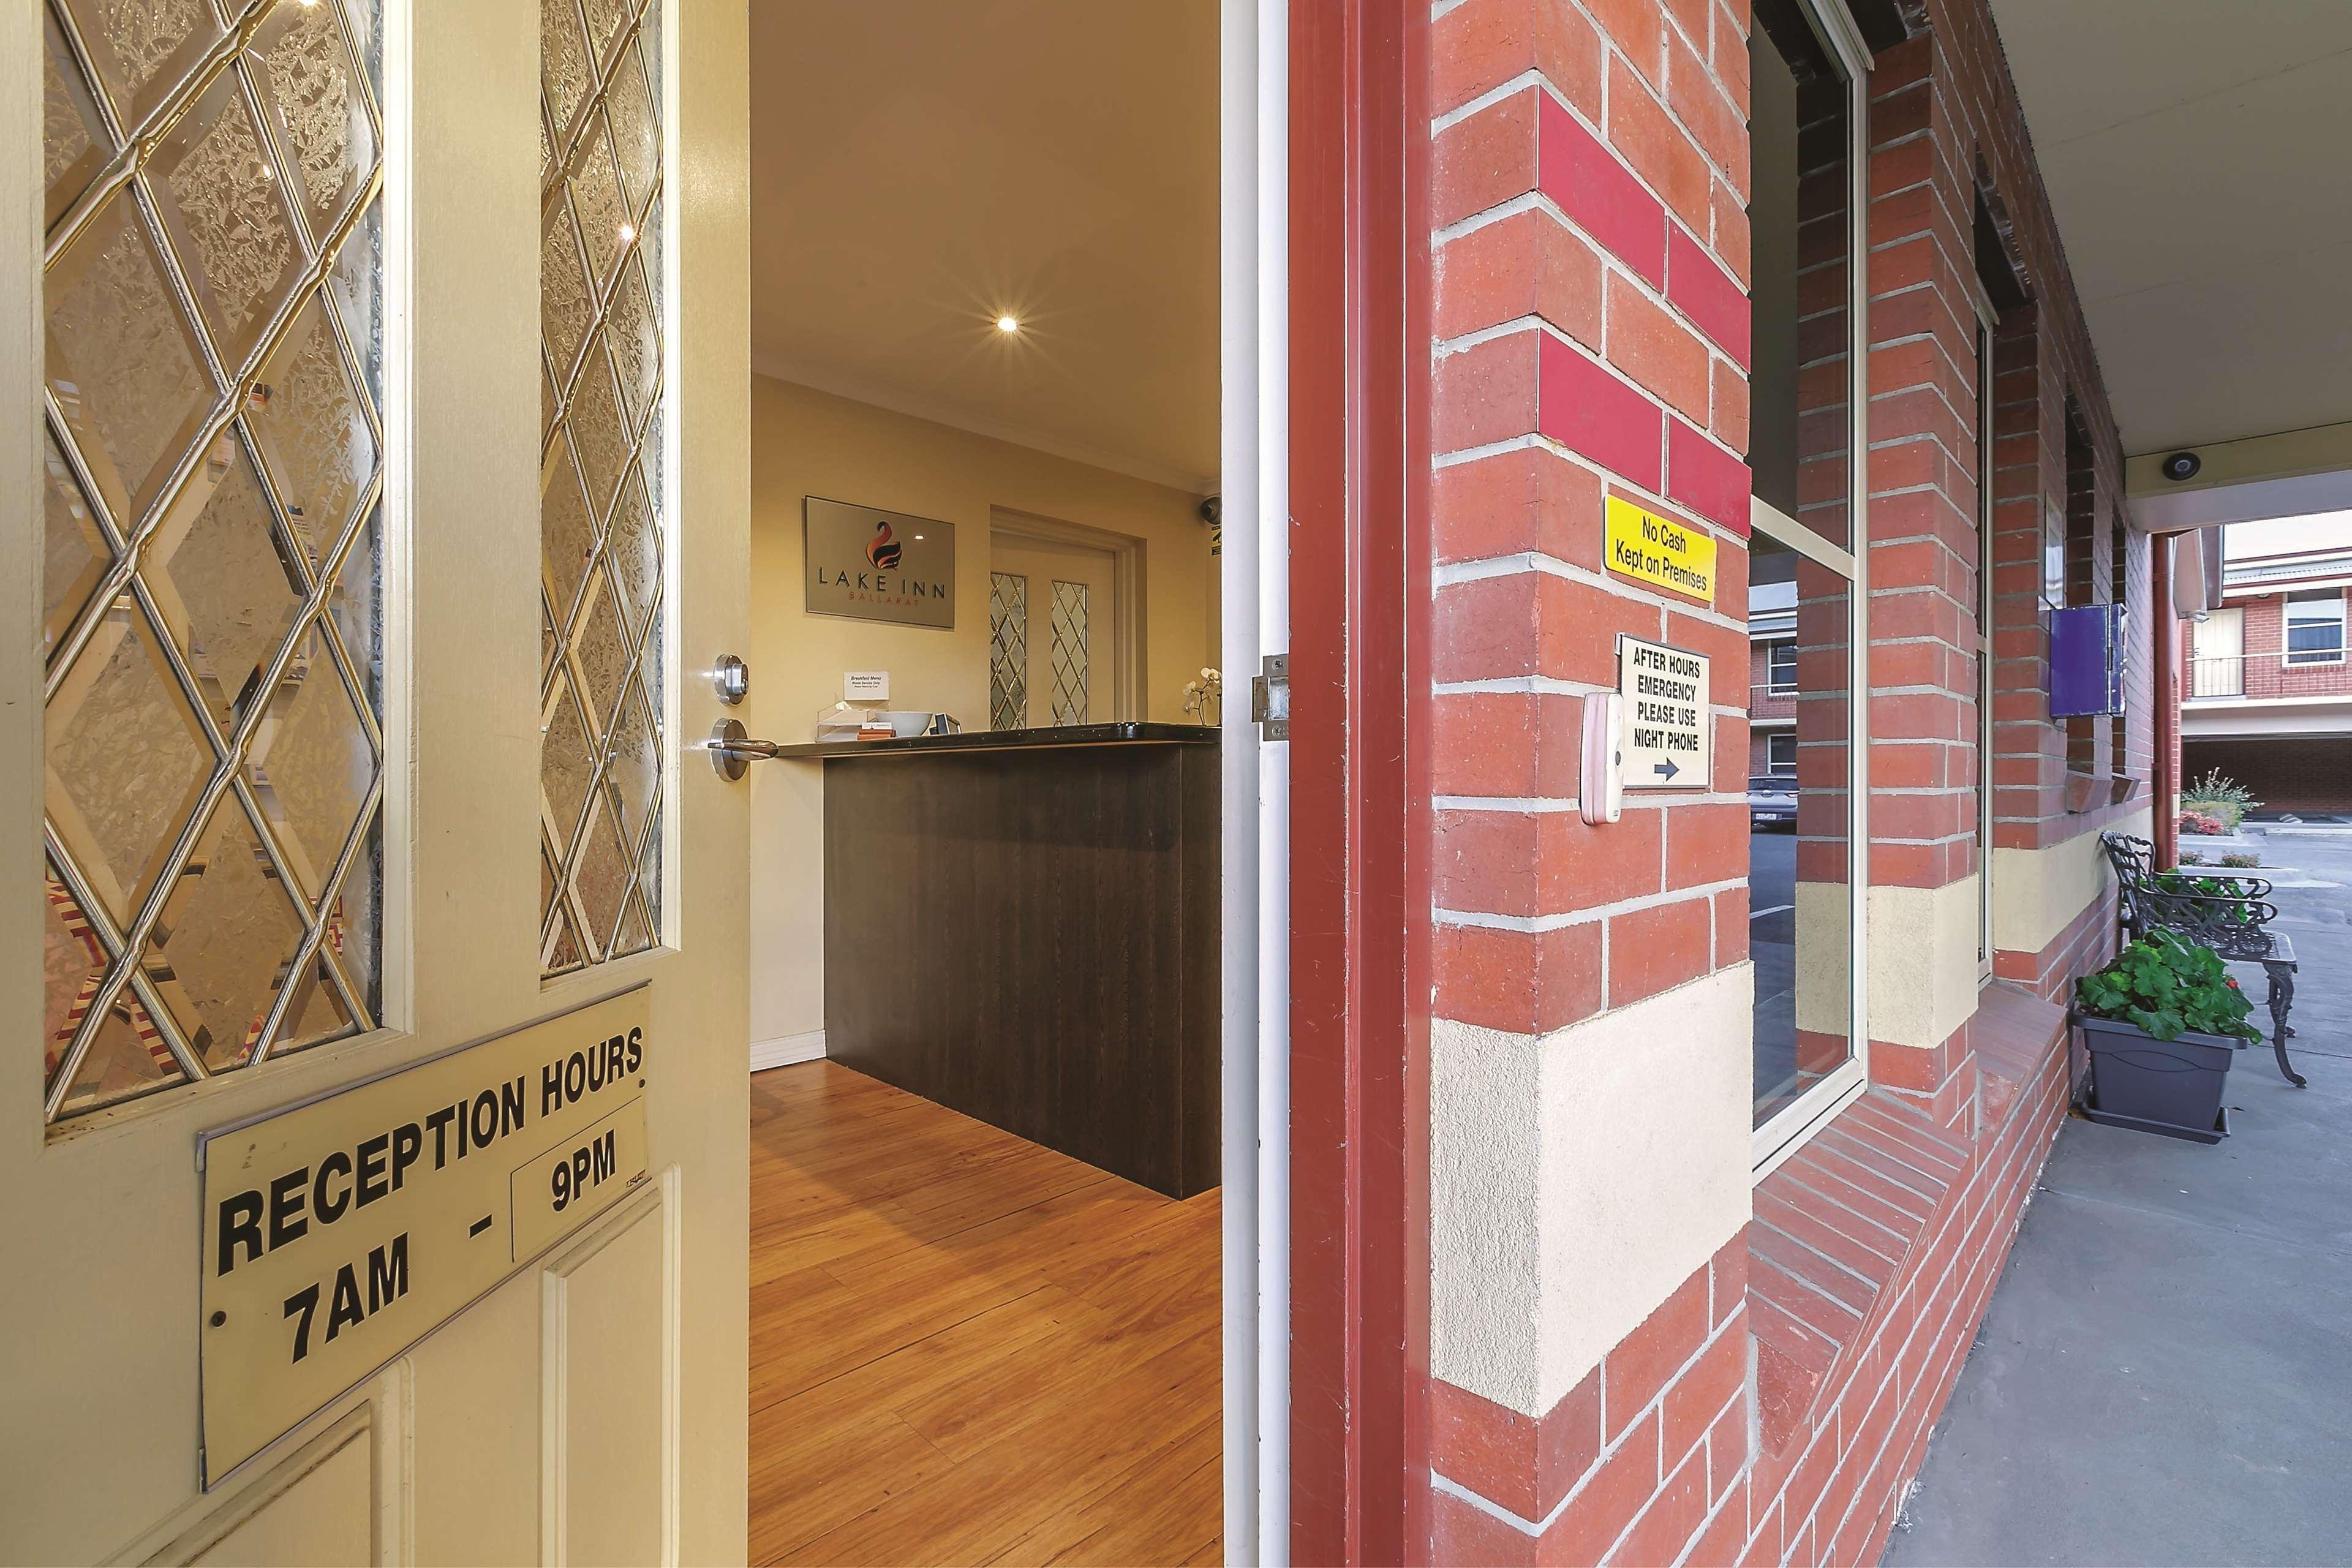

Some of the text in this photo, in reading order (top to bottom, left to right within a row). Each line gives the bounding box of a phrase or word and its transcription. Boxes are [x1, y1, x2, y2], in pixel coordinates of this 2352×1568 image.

[1643, 516, 1686, 554] No Cash
[1616, 539, 1707, 592] Kept on Premises
[819, 567, 946, 599] LAKE INN
[848, 590, 919, 607] BALLARAT
[1634, 646, 1700, 679] AFTER HOURS
[1637, 674, 1696, 703] EMERGENCY
[1637, 701, 1696, 727] PLEASE USE
[1634, 728, 1698, 752] NIGHT PHONE
[217, 1026, 643, 1278] RECEPTION HOURS
[282, 1231, 409, 1365] 7AM
[551, 1128, 616, 1212] 9PM
